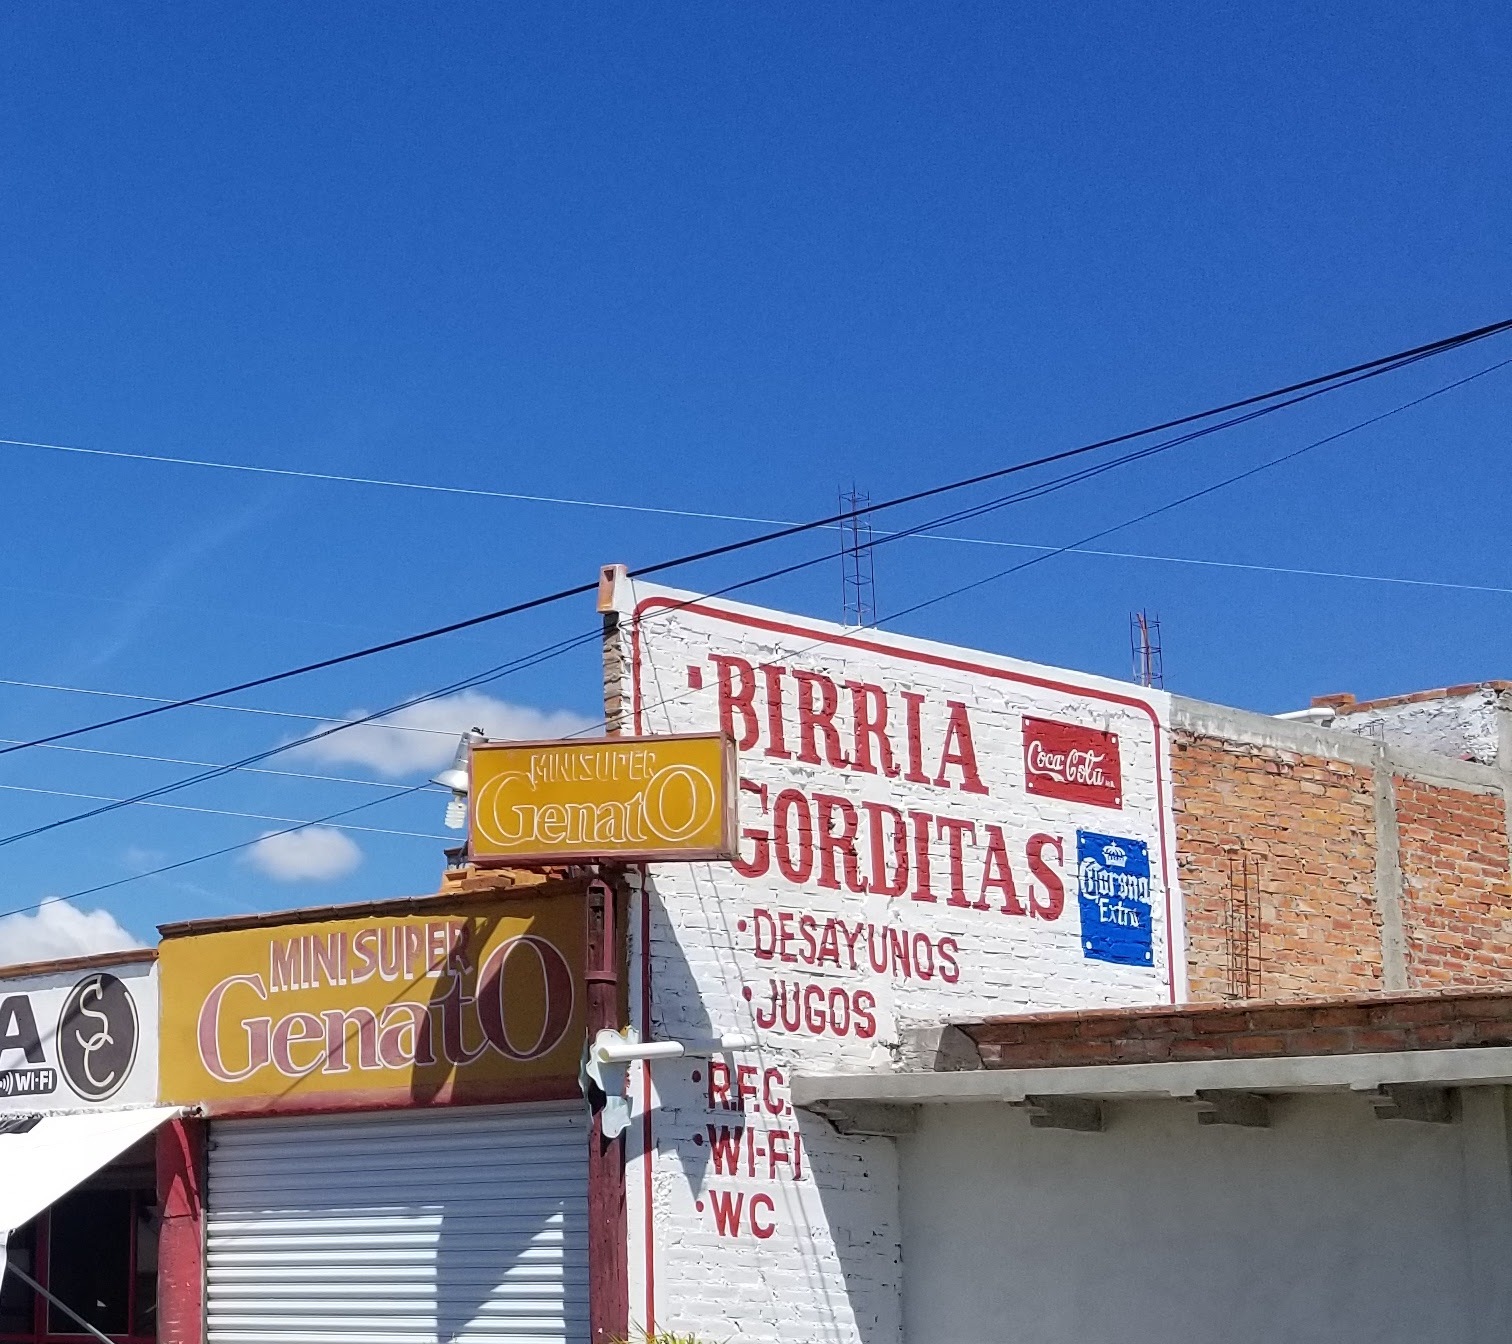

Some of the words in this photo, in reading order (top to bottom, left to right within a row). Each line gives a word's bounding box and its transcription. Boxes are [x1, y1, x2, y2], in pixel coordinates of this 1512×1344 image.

[707, 654, 989, 796] BIRRIA
[732, 777, 1065, 922] GORDITAS
[1079, 857, 1152, 904] Corona
[1099, 898, 1140, 927] Extra
[754, 908, 960, 984] DESAYUNOS
[756, 979, 877, 1039] JUGOS
[708, 1061, 792, 1116] R.F.C.
[706, 1123, 802, 1182] WI-FI
[708, 1189, 775, 1239] WC
